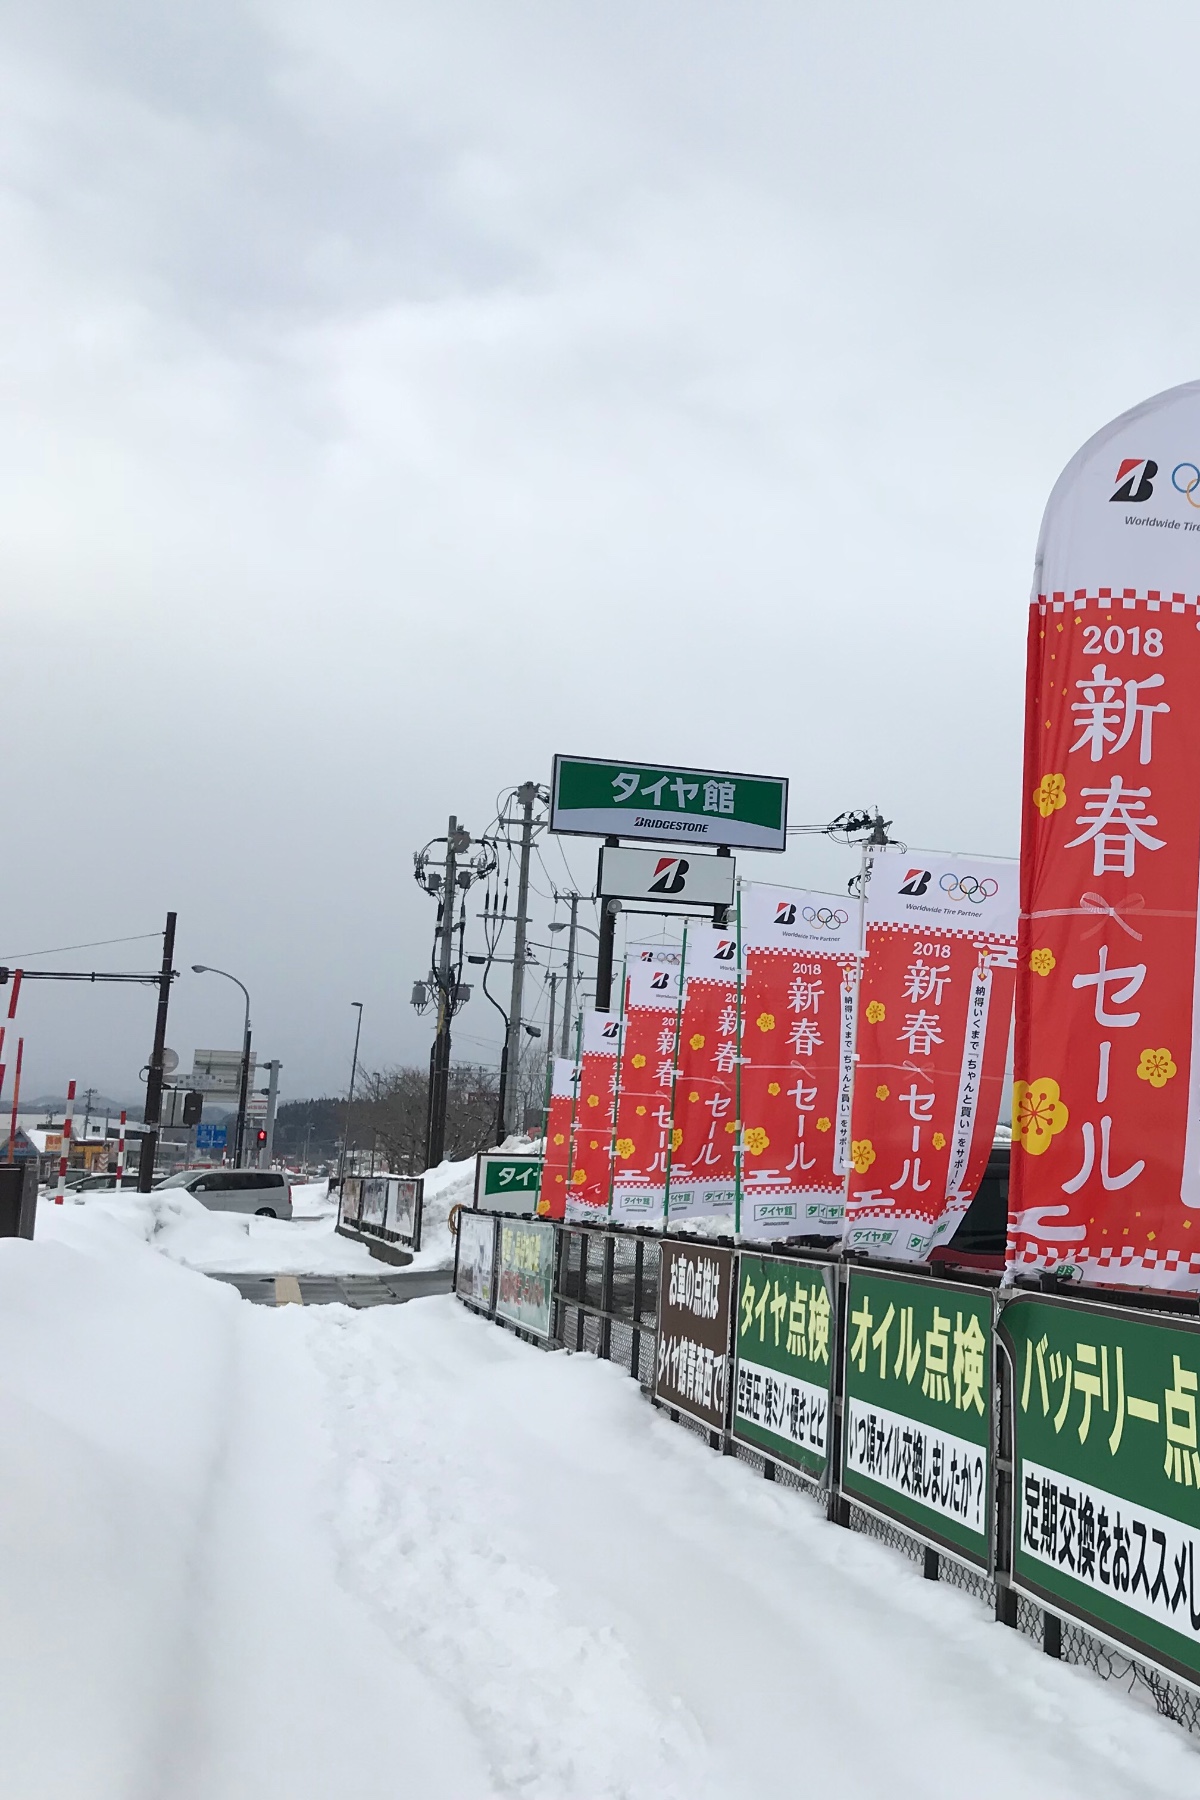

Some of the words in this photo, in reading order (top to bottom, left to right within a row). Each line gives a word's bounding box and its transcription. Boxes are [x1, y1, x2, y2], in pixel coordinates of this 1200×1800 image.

[1124, 515, 1180, 531] Worldwide
[1082, 625, 1164, 658] 2018
[610, 772, 736, 814] タイヤ館
[633, 816, 709, 833] BRIDGESTONE
[905, 903, 943, 914] Worldwide
[943, 908, 956, 916] Tire
[957, 909, 983, 918] Partner
[913, 941, 951, 959] 2018
[792, 962, 822, 975] 2018
[704, 1190, 744, 1202] タイヤ
[668, 1252, 720, 1320] お車の点検は
[740, 1274, 831, 1366] タイヤ点検
[850, 1295, 986, 1417] オイル点検
